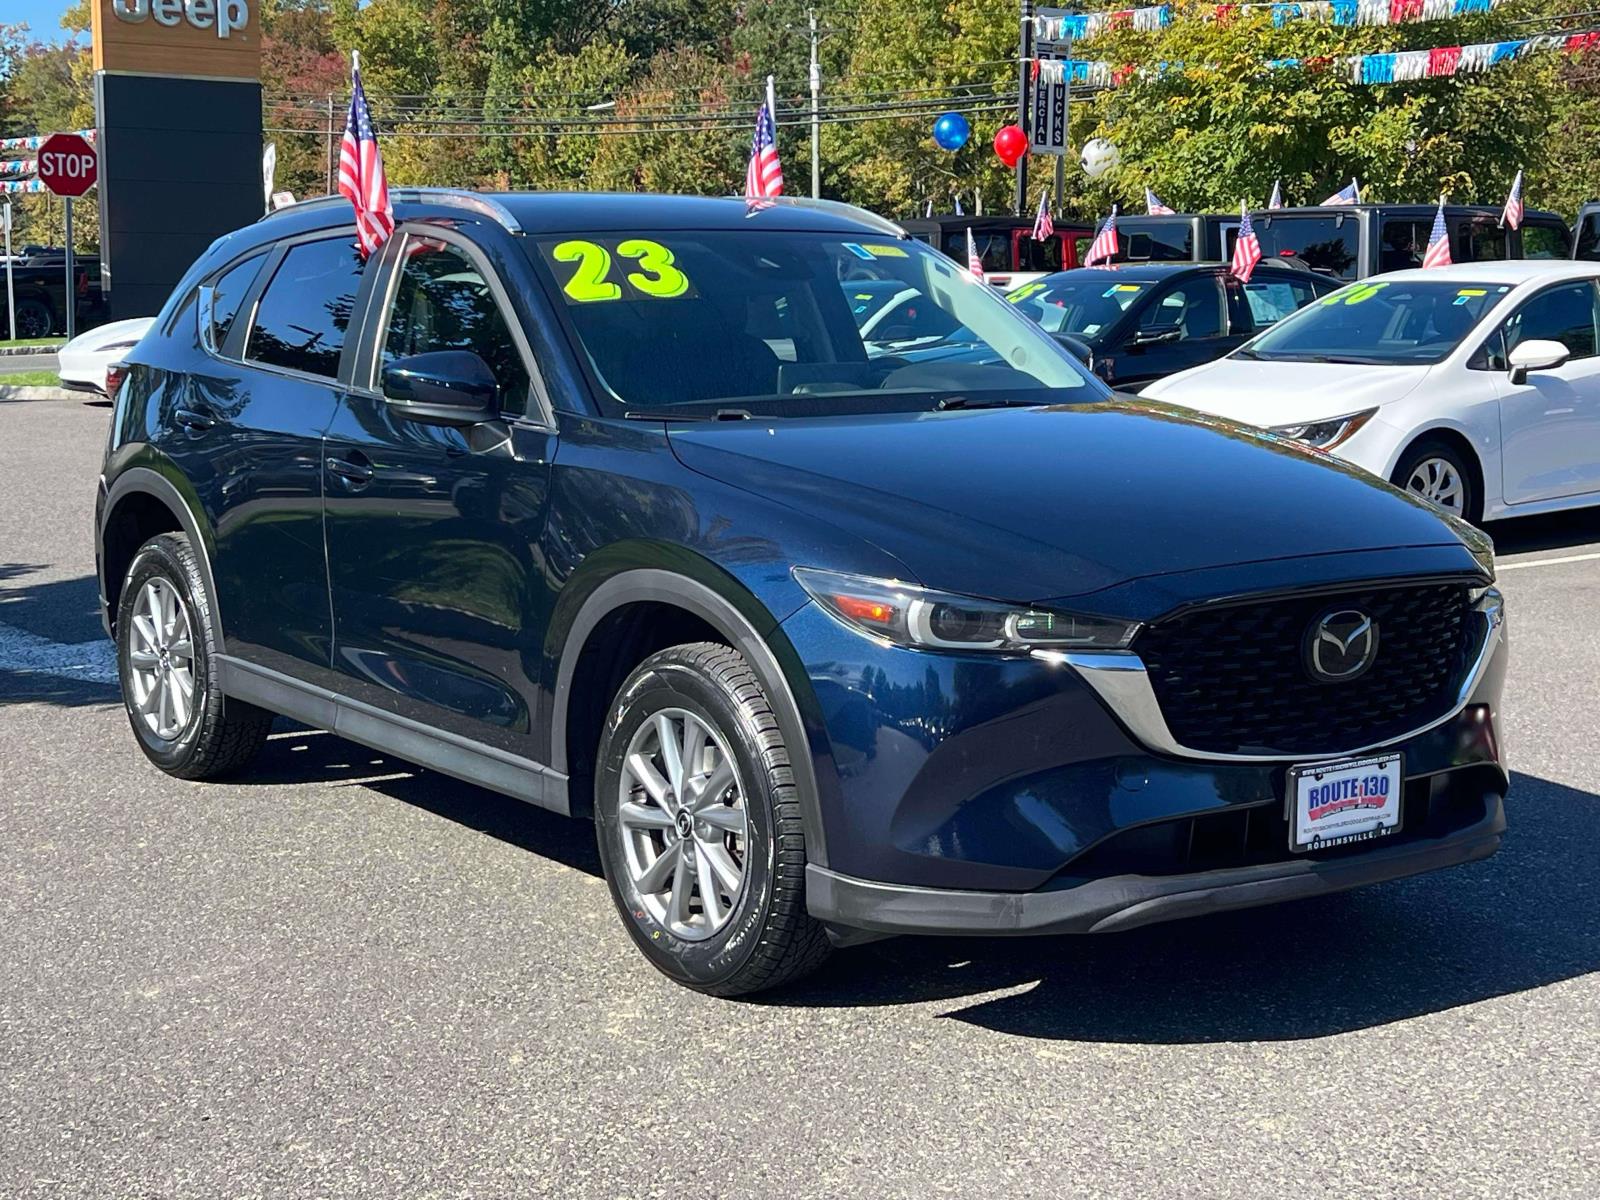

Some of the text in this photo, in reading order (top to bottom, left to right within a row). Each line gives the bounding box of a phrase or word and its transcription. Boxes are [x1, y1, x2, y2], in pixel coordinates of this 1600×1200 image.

[1037, 55, 1050, 144] MERCIAL
[41, 152, 95, 178] STOP
[553, 239, 689, 302] 23
[1321, 282, 1390, 305] 26
[1309, 775, 1390, 809] ROUTE 130
[1380, 828, 1392, 836] NJ
